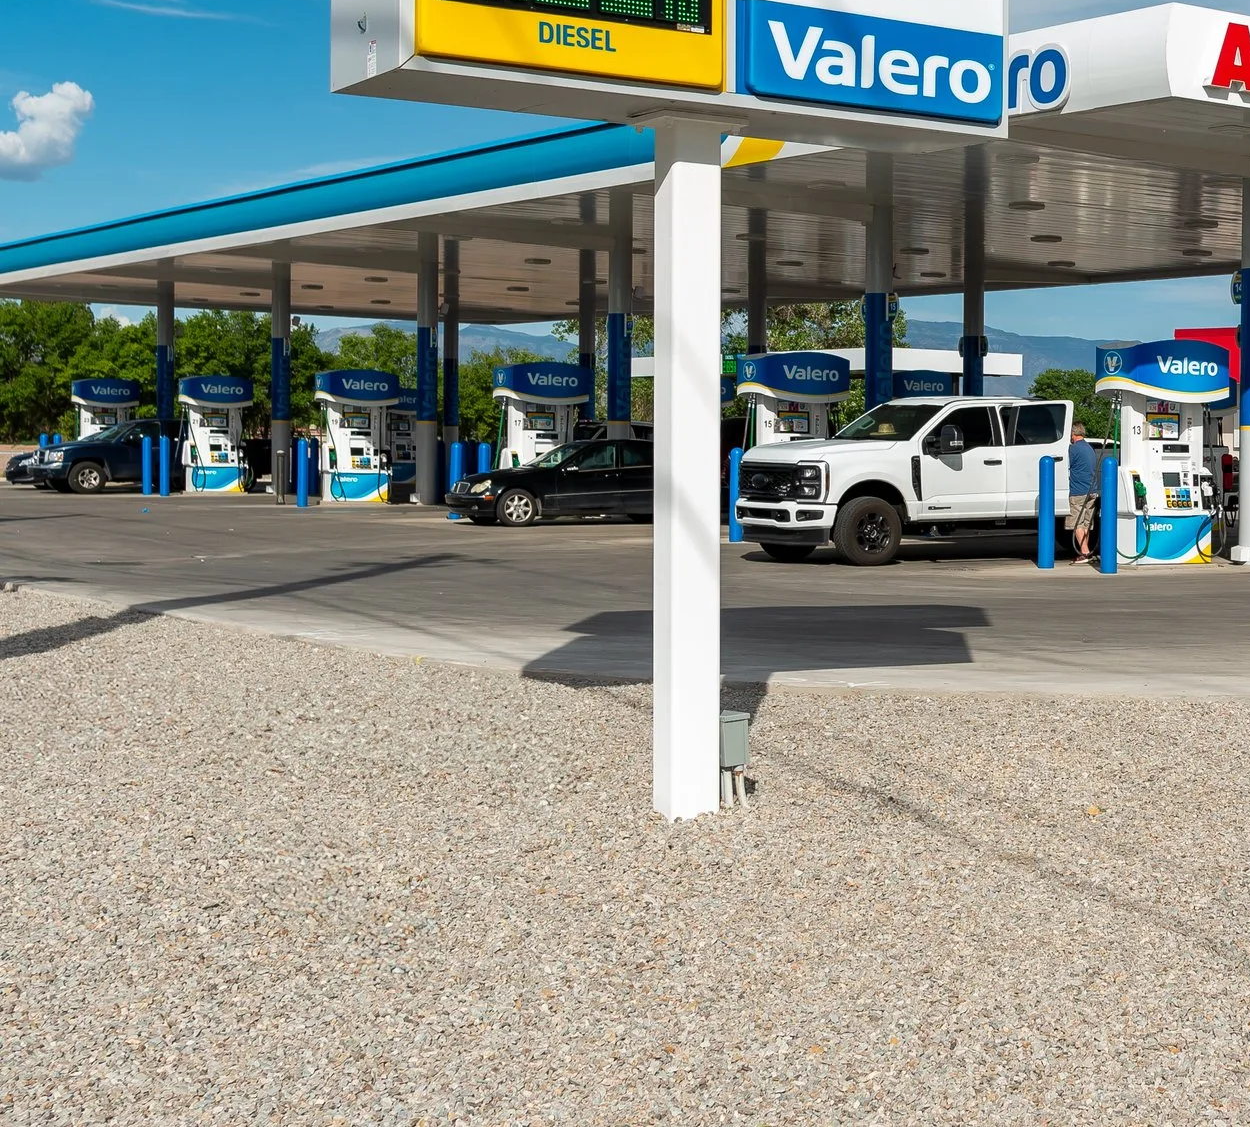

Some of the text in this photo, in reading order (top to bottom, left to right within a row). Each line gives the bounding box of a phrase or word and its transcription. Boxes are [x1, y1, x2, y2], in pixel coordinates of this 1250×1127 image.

[538, 21, 617, 53] DIESEL
[767, 19, 992, 104] Valero
[782, 364, 840, 382] Valero
[1156, 355, 1219, 377] Valero
[342, 377, 389, 392] Valero
[527, 372, 579, 387] Valero
[903, 379, 945, 392] Valero
[91, 384, 131, 396] Valero
[200, 383, 244, 395] Valero
[514, 419, 522, 427] 17
[764, 420, 773, 428] 15
[1132, 425, 1142, 436] 13
